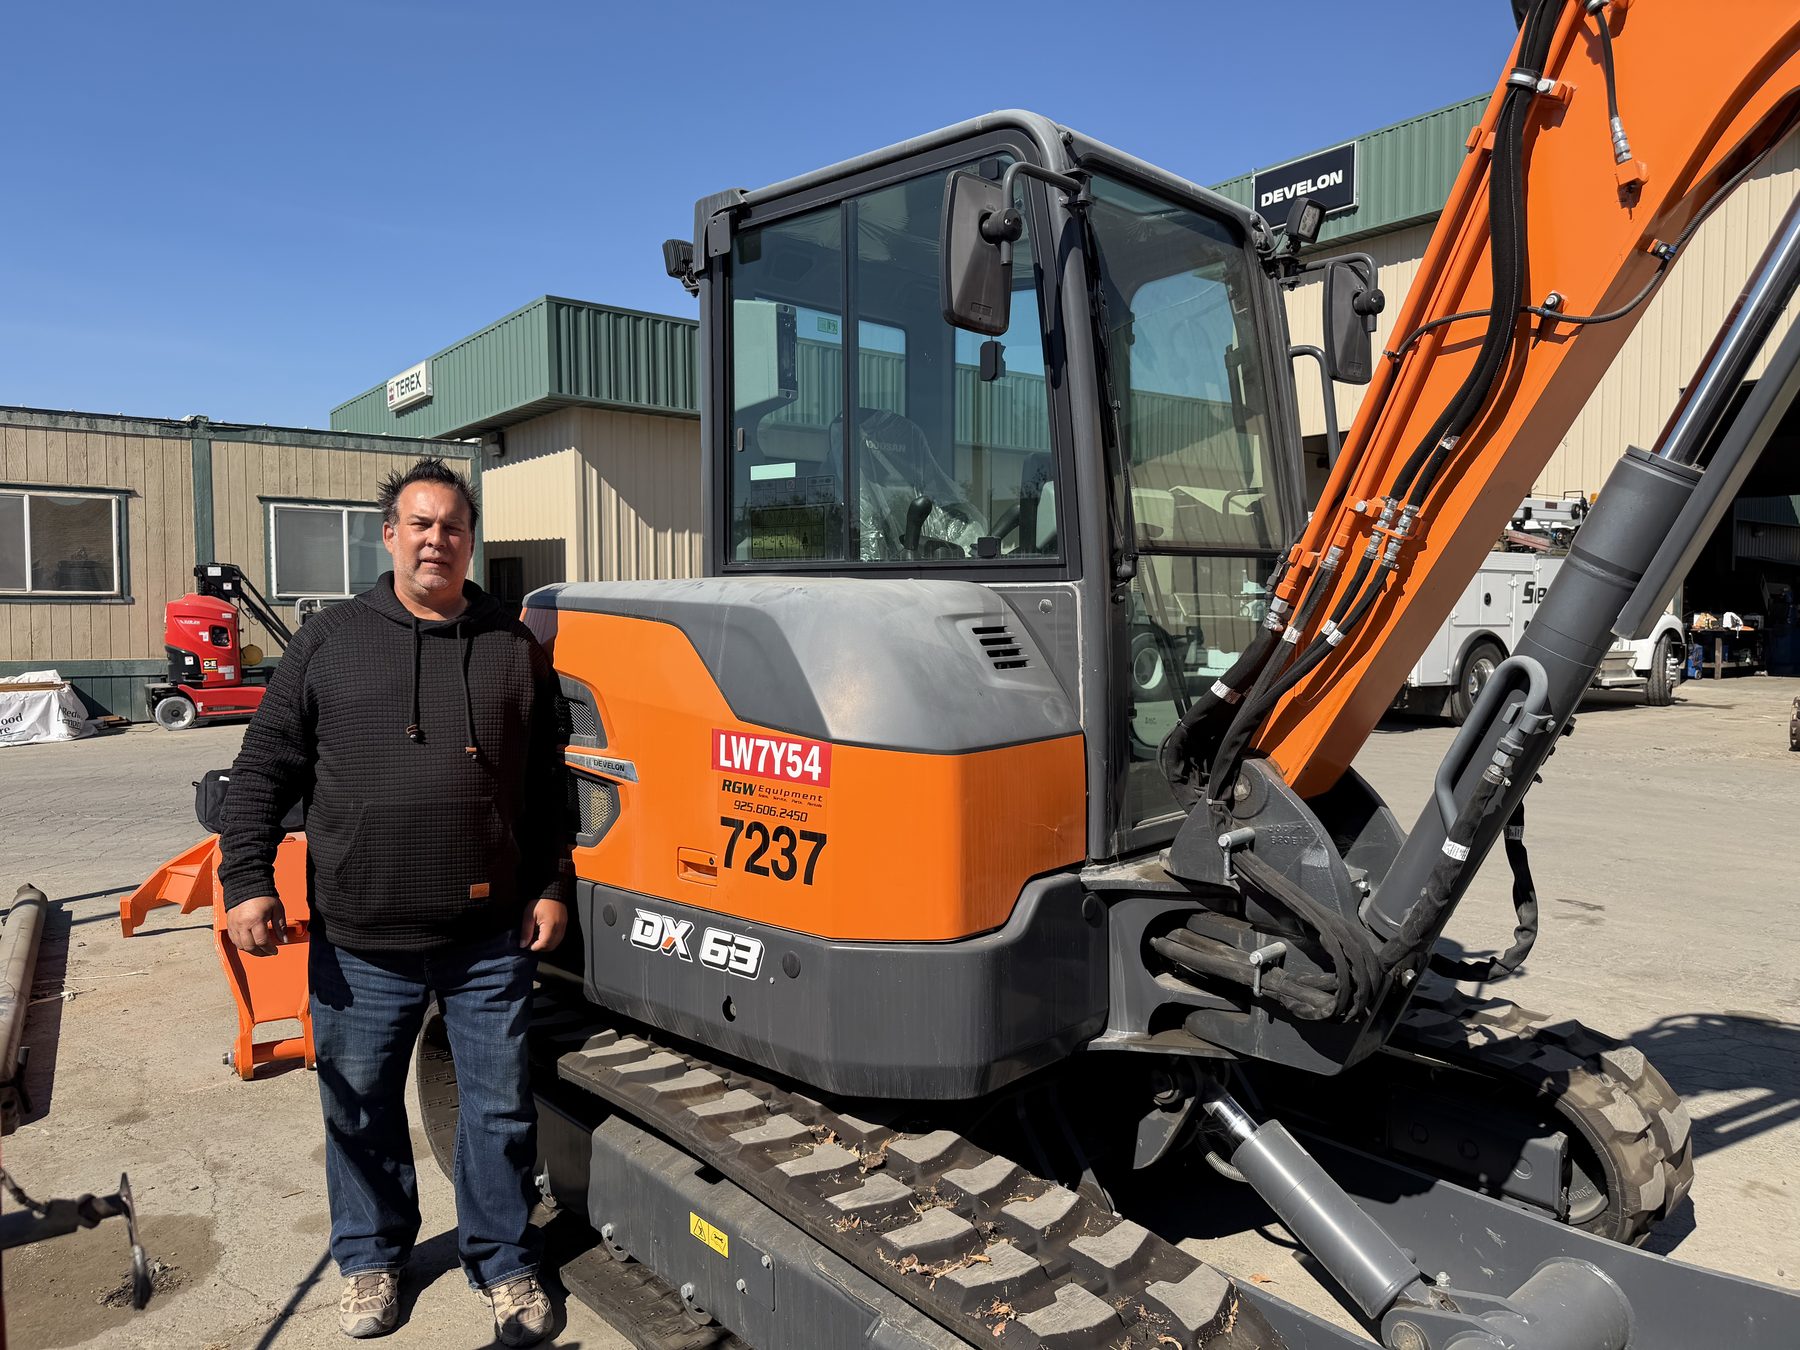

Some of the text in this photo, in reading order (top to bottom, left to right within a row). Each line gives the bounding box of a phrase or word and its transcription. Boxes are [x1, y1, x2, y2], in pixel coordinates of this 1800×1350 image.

[1260, 169, 1343, 207] DEVELON
[395, 370, 421, 398] TEREX
[1521, 581, 1547, 603] Se
[0, 726, 11, 735] re
[1, 712, 23, 726] ood
[593, 759, 625, 772] DEVELON
[719, 733, 822, 781] LW7Y54
[721, 779, 823, 802] RGW Equipment
[733, 799, 808, 823] 925.606.2450
[720, 815, 827, 886] 7237
[630, 908, 765, 980] DX 63
